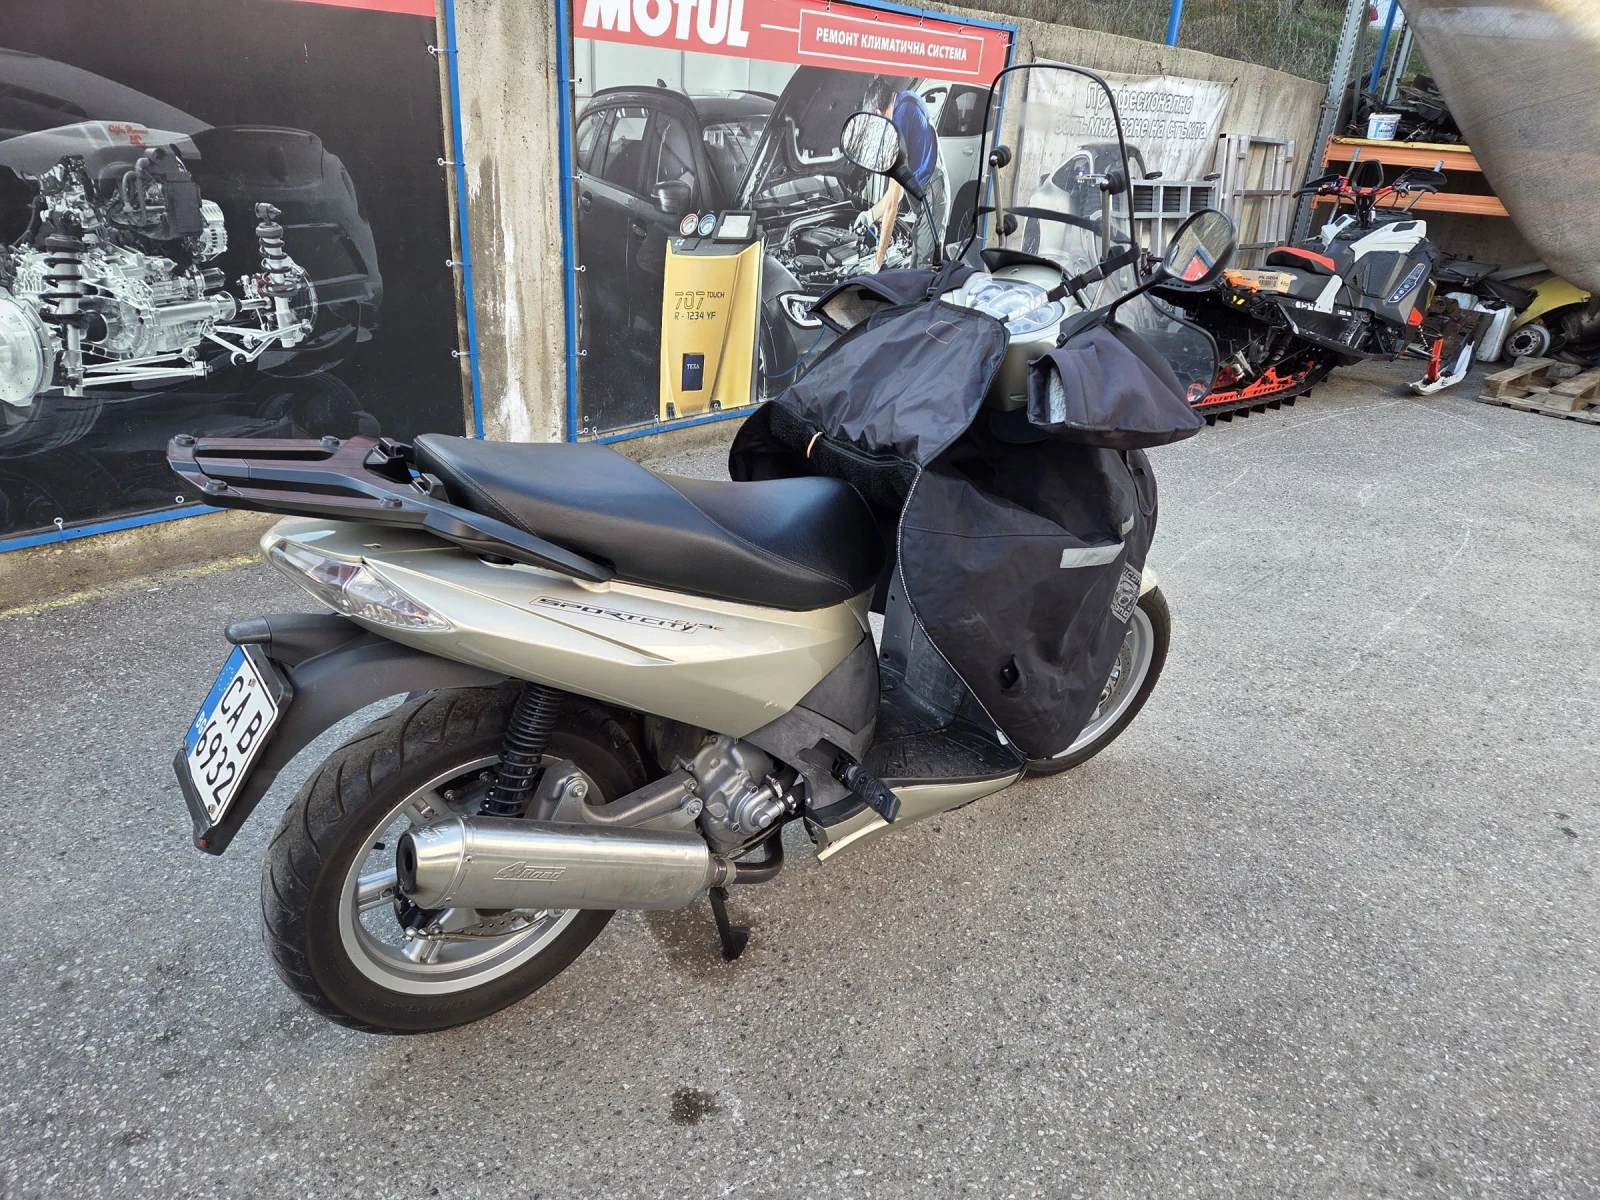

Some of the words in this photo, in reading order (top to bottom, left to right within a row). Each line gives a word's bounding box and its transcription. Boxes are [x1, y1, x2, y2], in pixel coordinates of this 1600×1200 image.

[582, 0, 749, 48] MOTUL
[816, 27, 860, 47] РЕМОНТ
[861, 34, 925, 56] КЛИМАТИЧНА
[927, 43, 967, 61] СИСТЕМА
[1149, 119, 1165, 138] на
[1167, 120, 1207, 140] стъкла
[675, 291, 705, 310] 707
[687, 311, 704, 320] 1234
[706, 311, 716, 320] YF
[195, 710, 207, 735] BG
[196, 720, 235, 806] 6932
